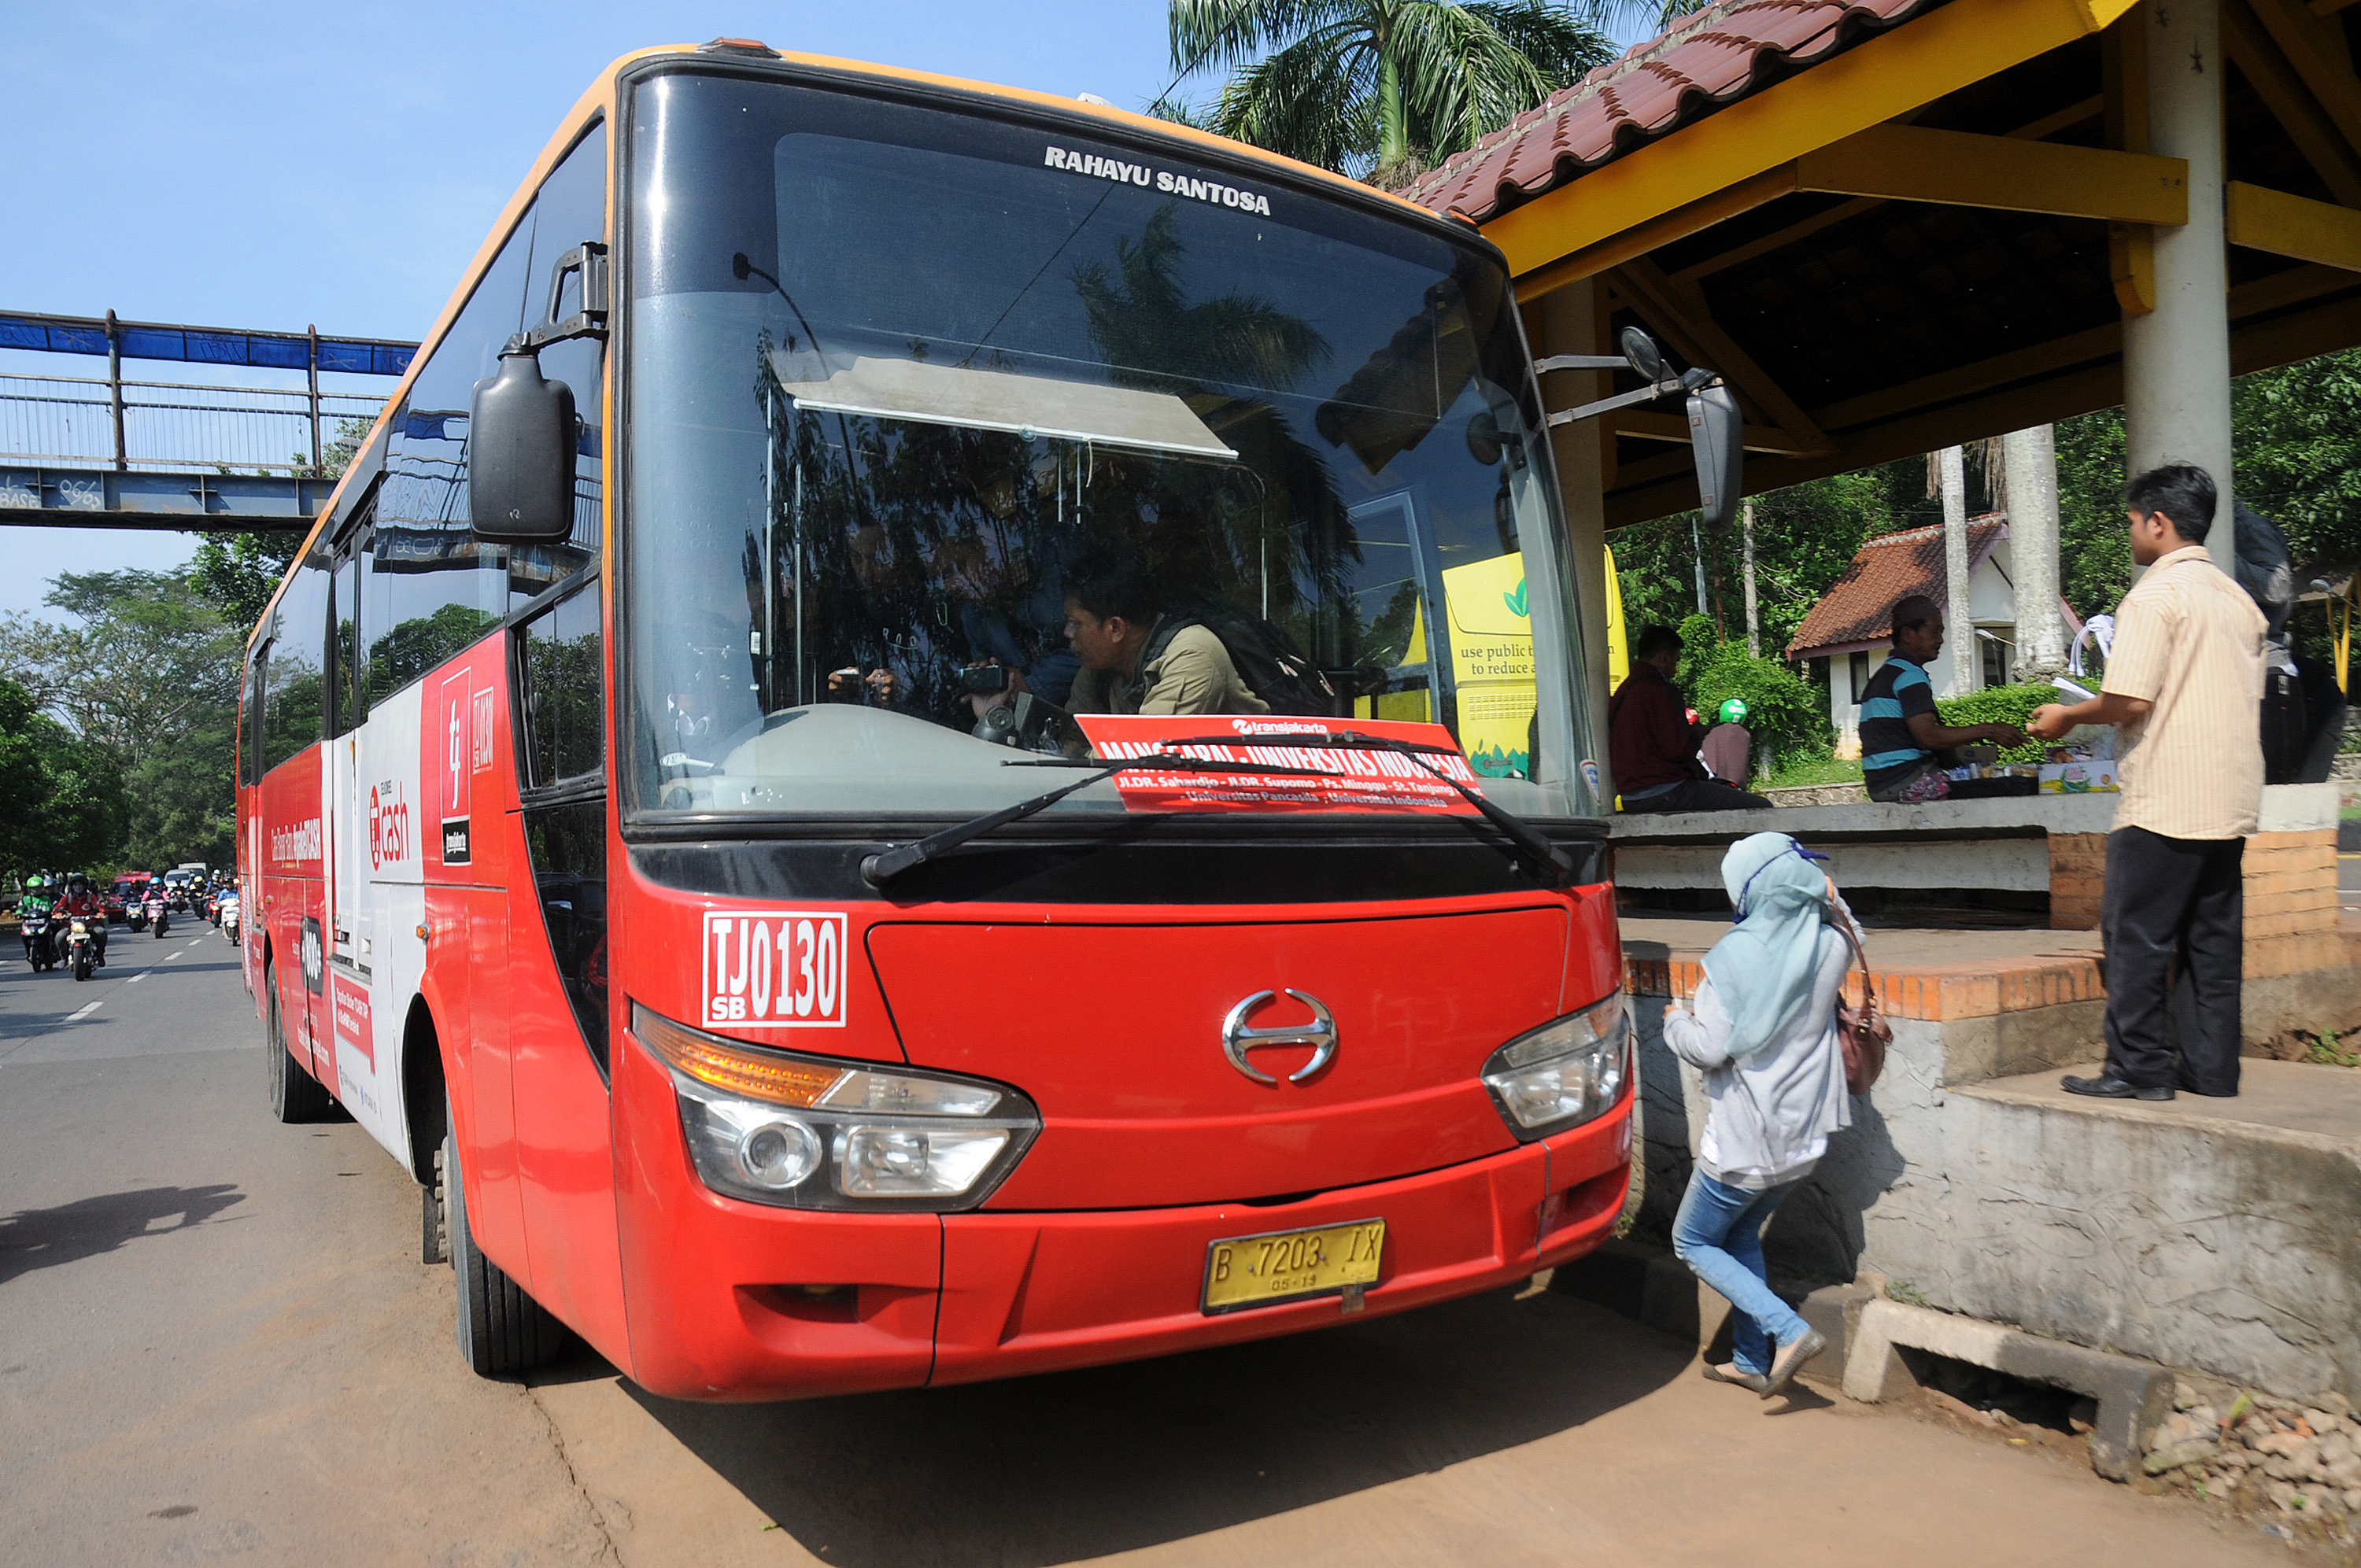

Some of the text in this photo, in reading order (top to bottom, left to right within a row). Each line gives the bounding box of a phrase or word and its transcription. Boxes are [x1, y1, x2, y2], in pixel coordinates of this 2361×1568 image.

[1044, 146, 1271, 216] RAHAYU SANTOSA
[1461, 648, 1483, 658] use
[1487, 644, 1525, 661] public
[1472, 664, 1483, 674] to
[1487, 661, 1528, 674] reduce
[1251, 721, 1328, 735] transjakarta
[1158, 777, 1219, 788] Sahardjo
[1263, 777, 1316, 789] Supomo
[1341, 779, 1387, 791] Minggu
[1408, 781, 1456, 796] Tanjung
[1185, 791, 1261, 801] Universitas
[1260, 791, 1320, 802] Pancasila
[1327, 791, 1394, 804] Universitas
[1392, 795, 1448, 807] Indonesia
[711, 996, 746, 1020] SB
[1214, 1247, 1232, 1283] B
[1258, 1236, 1322, 1276] 7203
